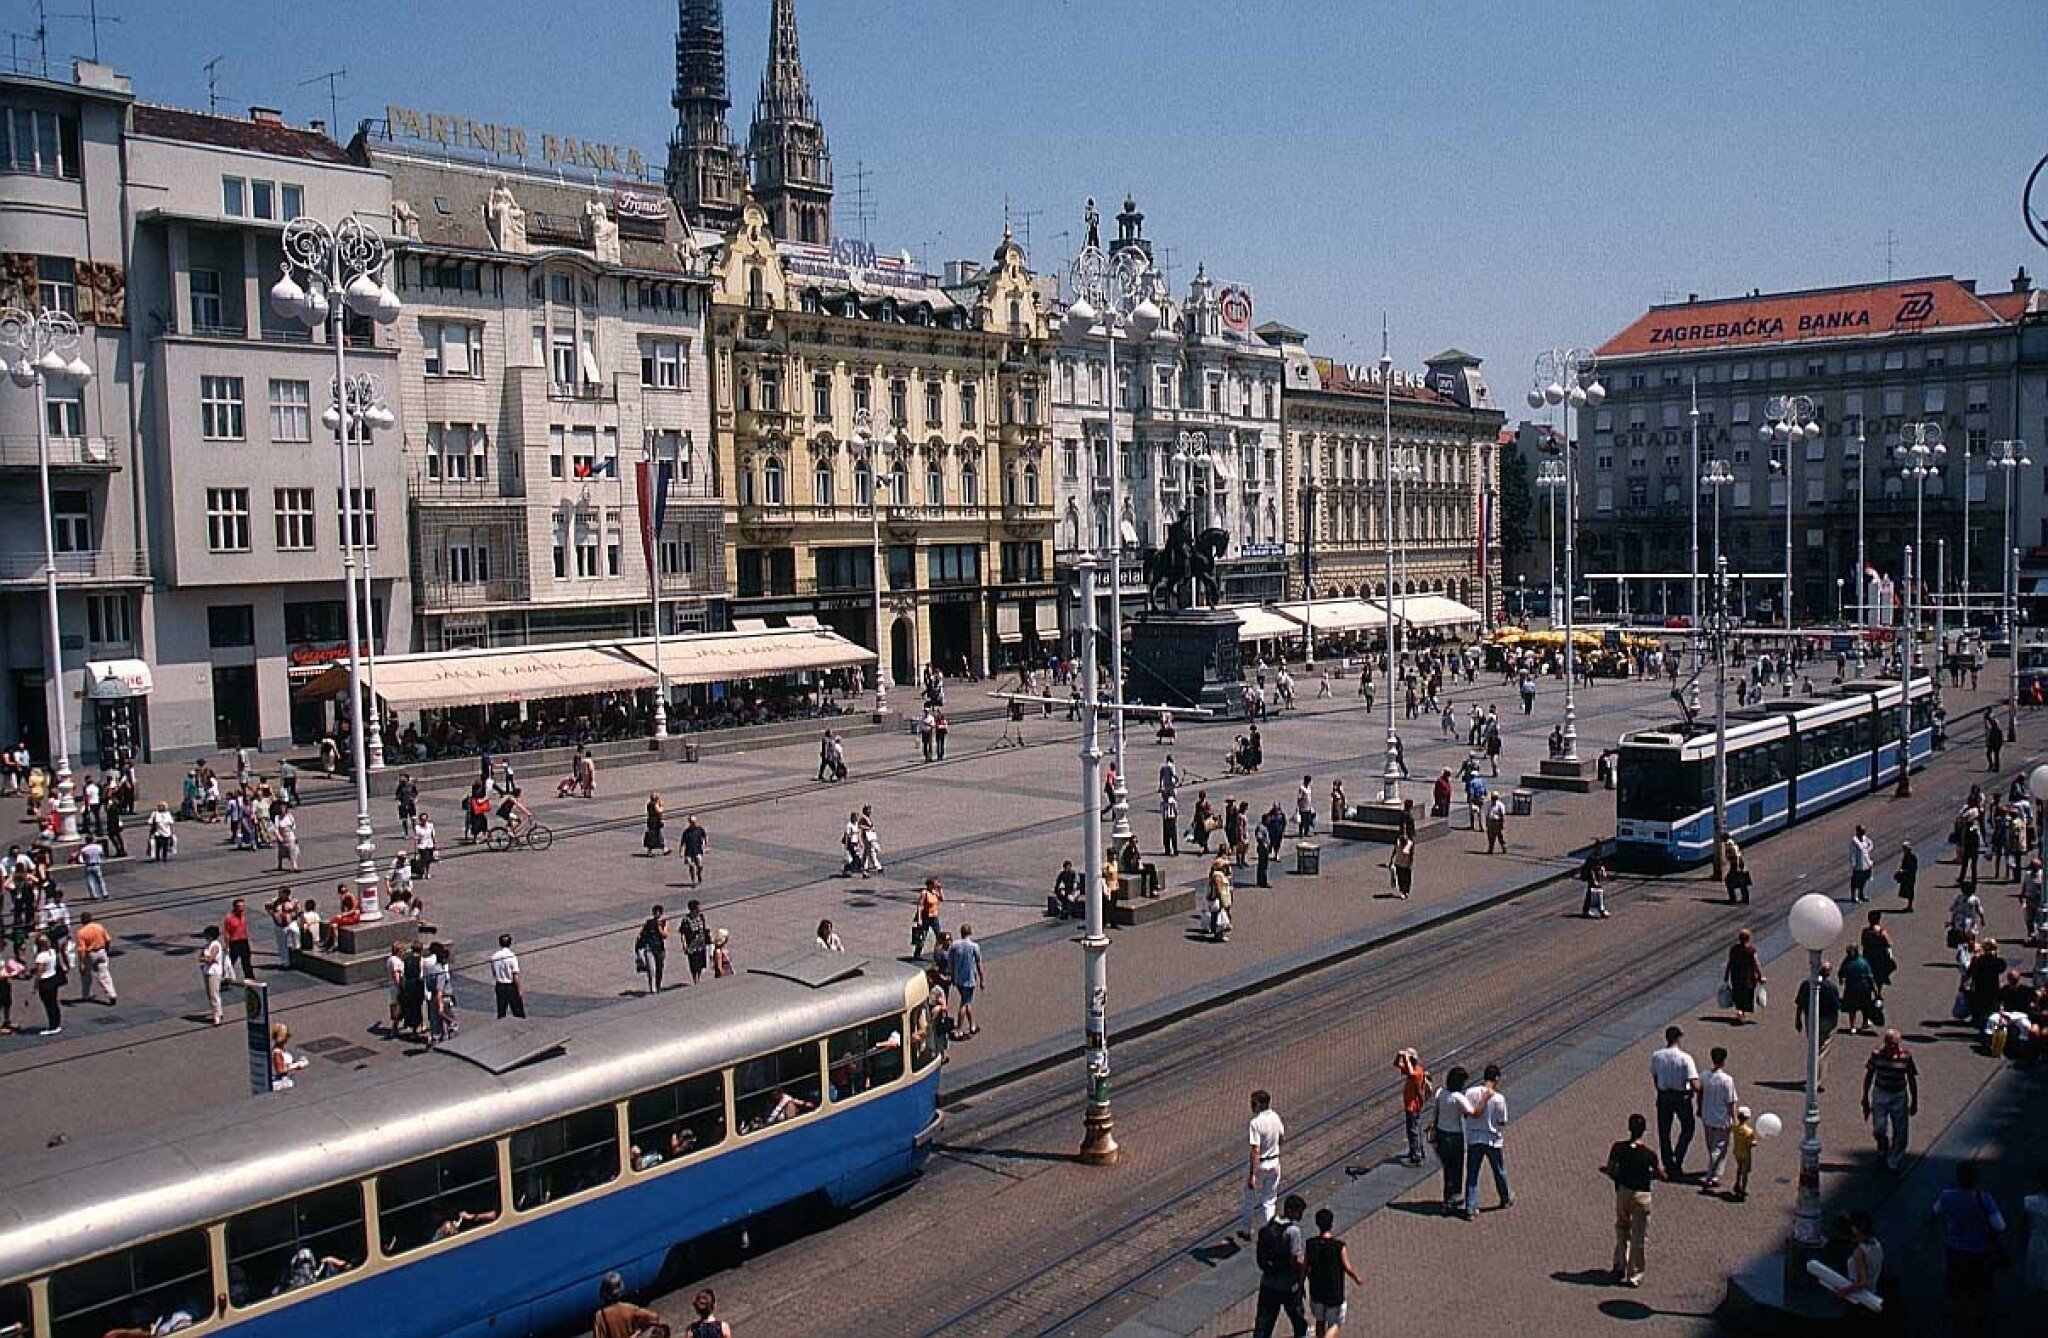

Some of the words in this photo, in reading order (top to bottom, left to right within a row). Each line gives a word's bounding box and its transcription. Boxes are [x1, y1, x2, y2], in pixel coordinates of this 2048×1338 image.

[386, 105, 528, 156] PARTNER
[542, 134, 646, 177] BANKA
[829, 235, 877, 270] ASTRA
[1650, 315, 1784, 344] ZAGREBAČKA
[1798, 309, 1870, 331] BANKA
